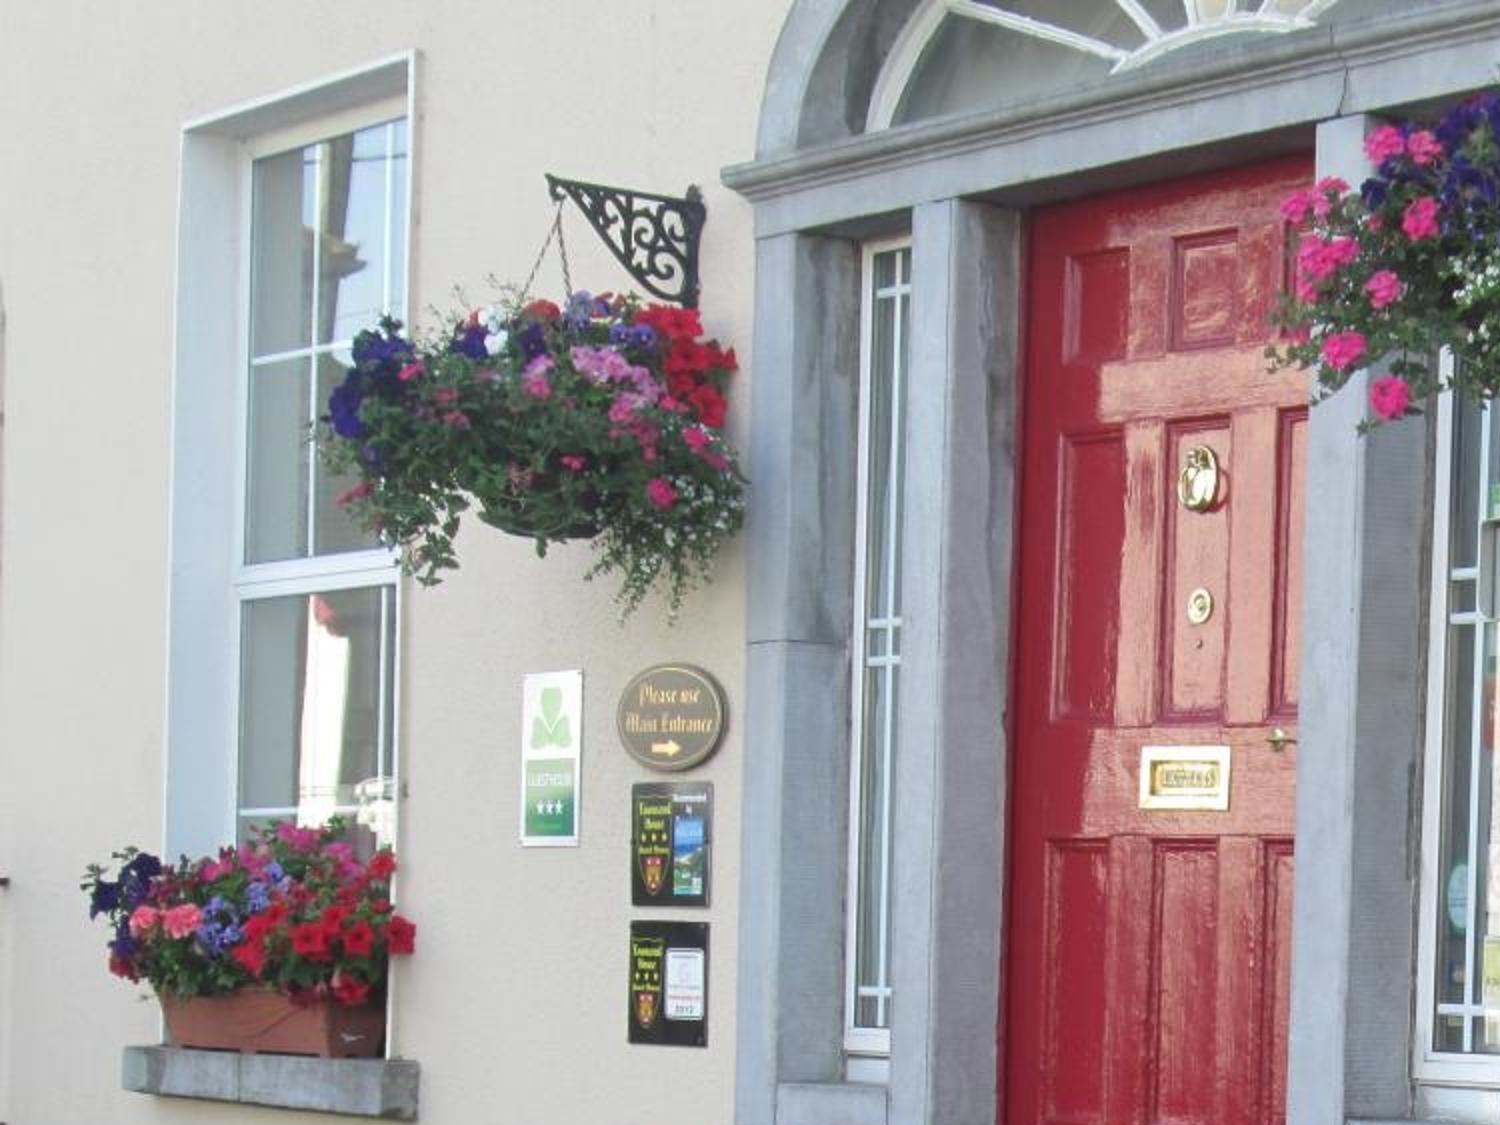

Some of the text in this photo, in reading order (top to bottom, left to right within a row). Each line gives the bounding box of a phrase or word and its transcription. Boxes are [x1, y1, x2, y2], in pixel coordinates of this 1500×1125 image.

[640, 684, 677, 707] Please
[625, 712, 713, 733] Main Entrance
